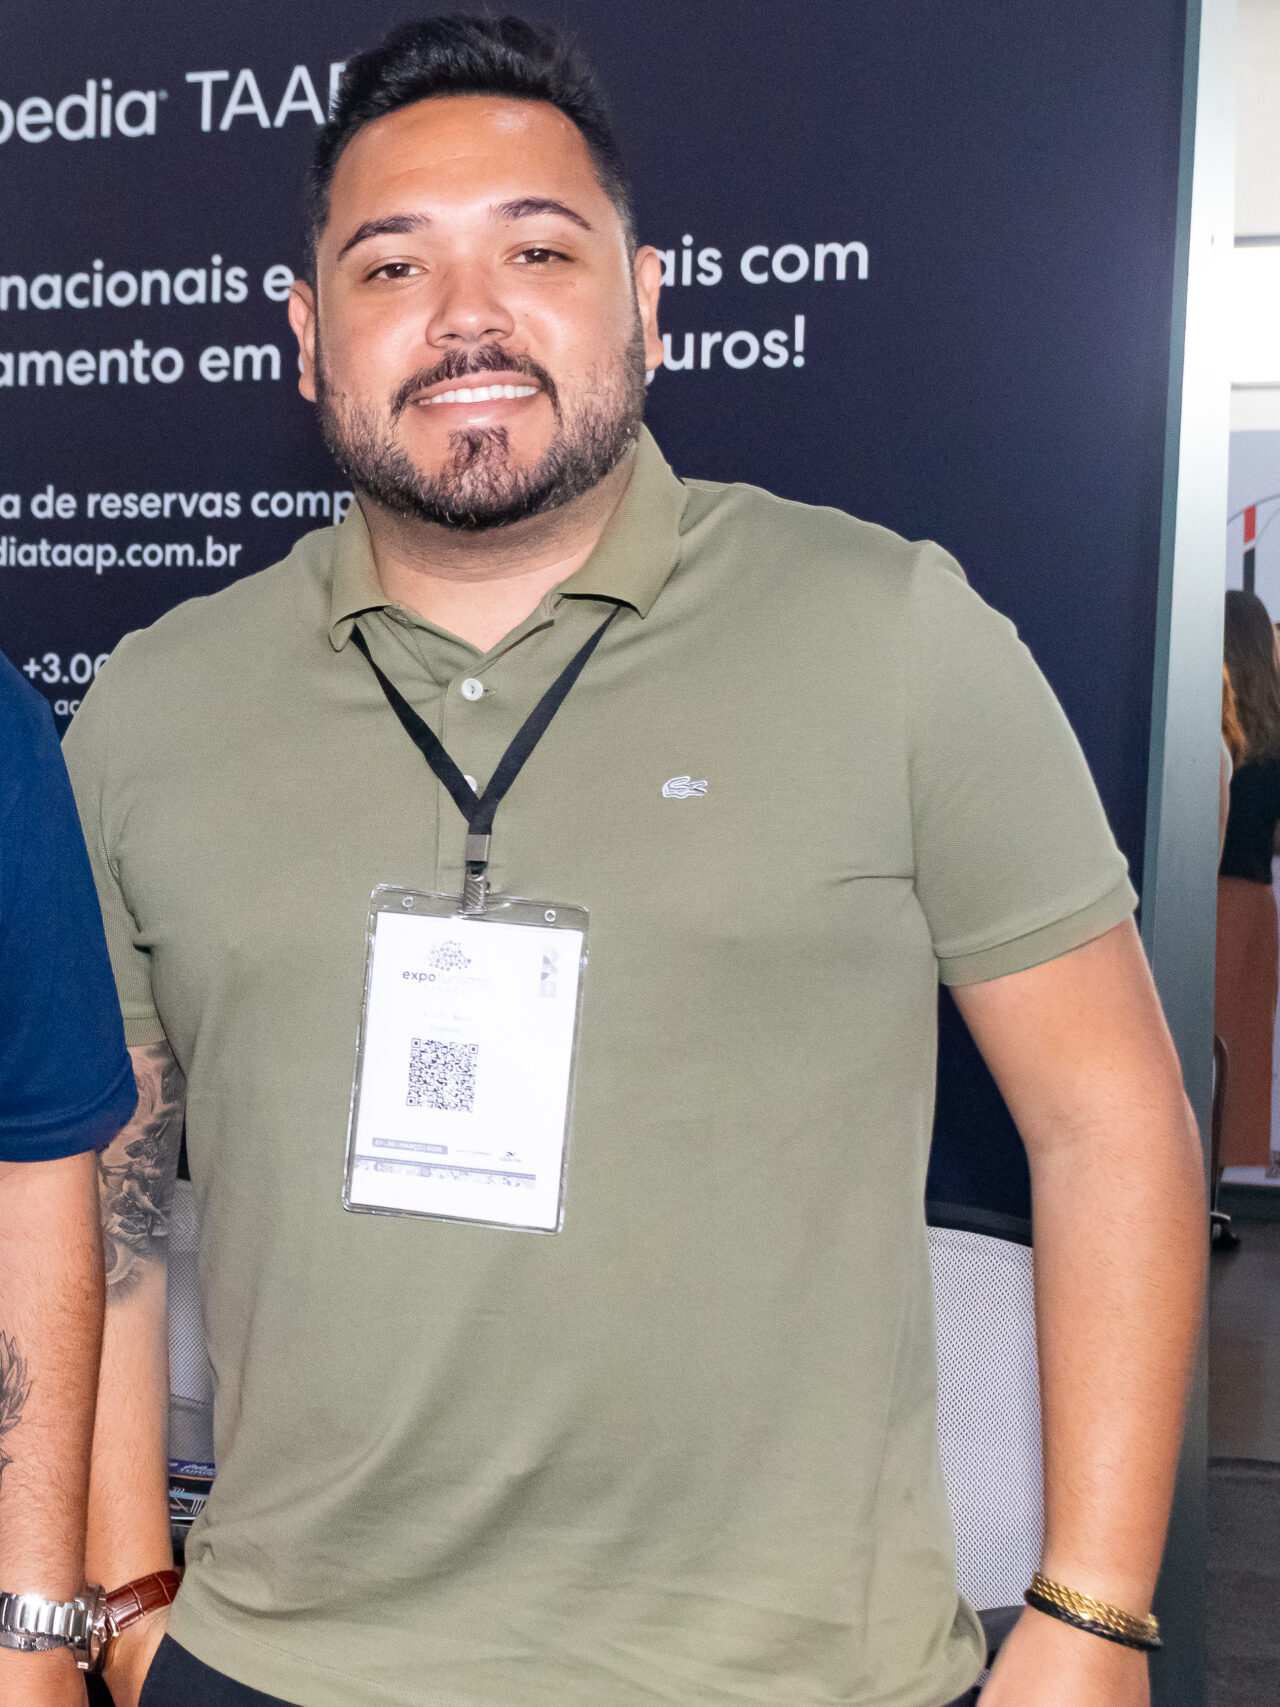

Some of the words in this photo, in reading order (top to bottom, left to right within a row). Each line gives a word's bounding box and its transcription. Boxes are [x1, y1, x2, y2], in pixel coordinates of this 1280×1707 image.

[263, 264, 295, 301] e
[740, 241, 868, 285] com
[199, 343, 281, 383] em
[30, 484, 76, 519] de
[87, 489, 241, 519] reservas
